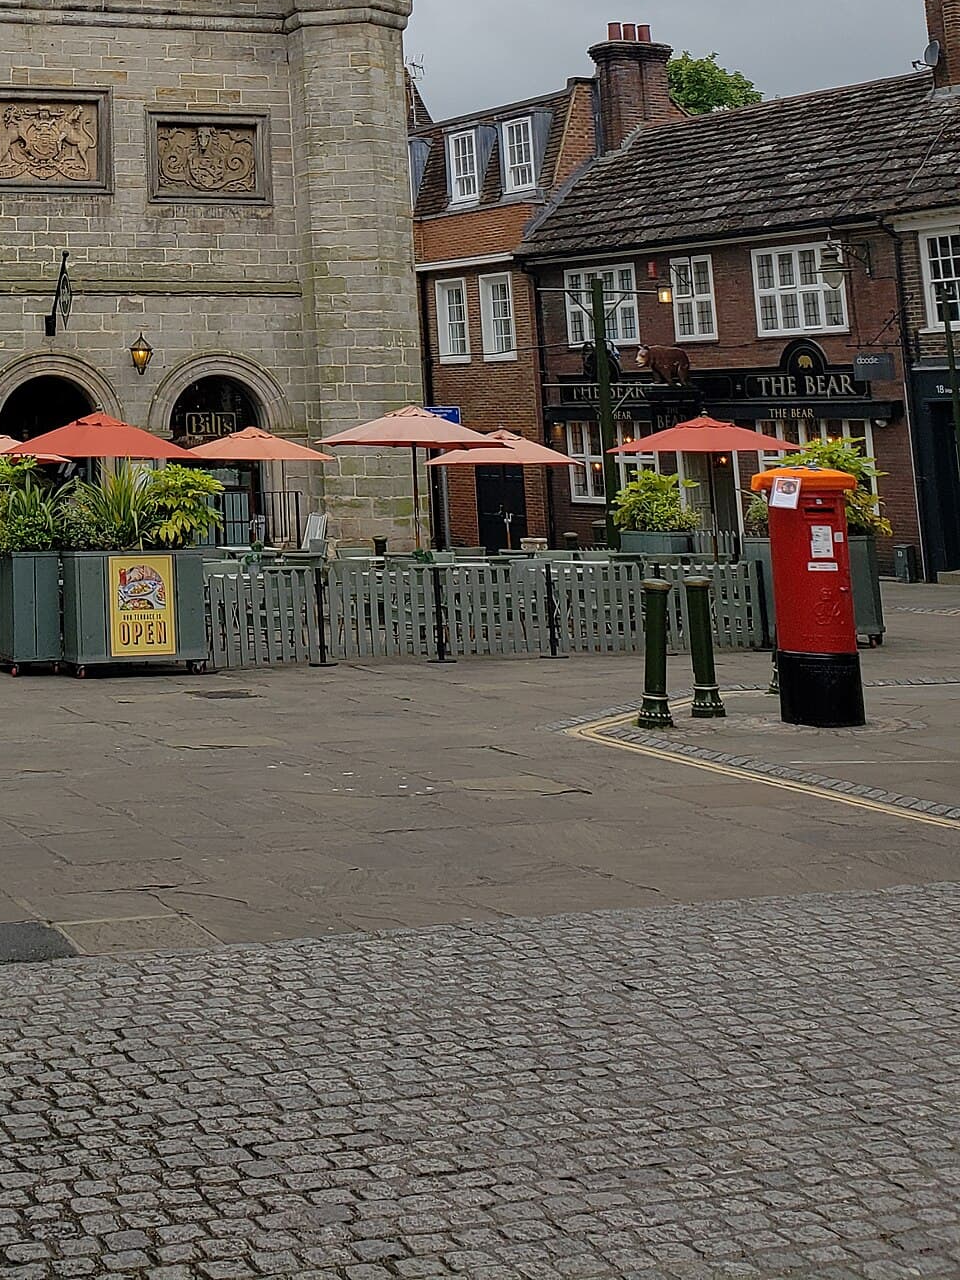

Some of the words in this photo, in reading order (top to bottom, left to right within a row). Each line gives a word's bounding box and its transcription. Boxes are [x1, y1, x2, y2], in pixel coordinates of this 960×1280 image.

[757, 375, 797, 397] THE
[805, 374, 857, 396] BEAR
[768, 408, 787, 418] THE
[791, 407, 815, 418] BEAR
[120, 621, 167, 646] OPEN
